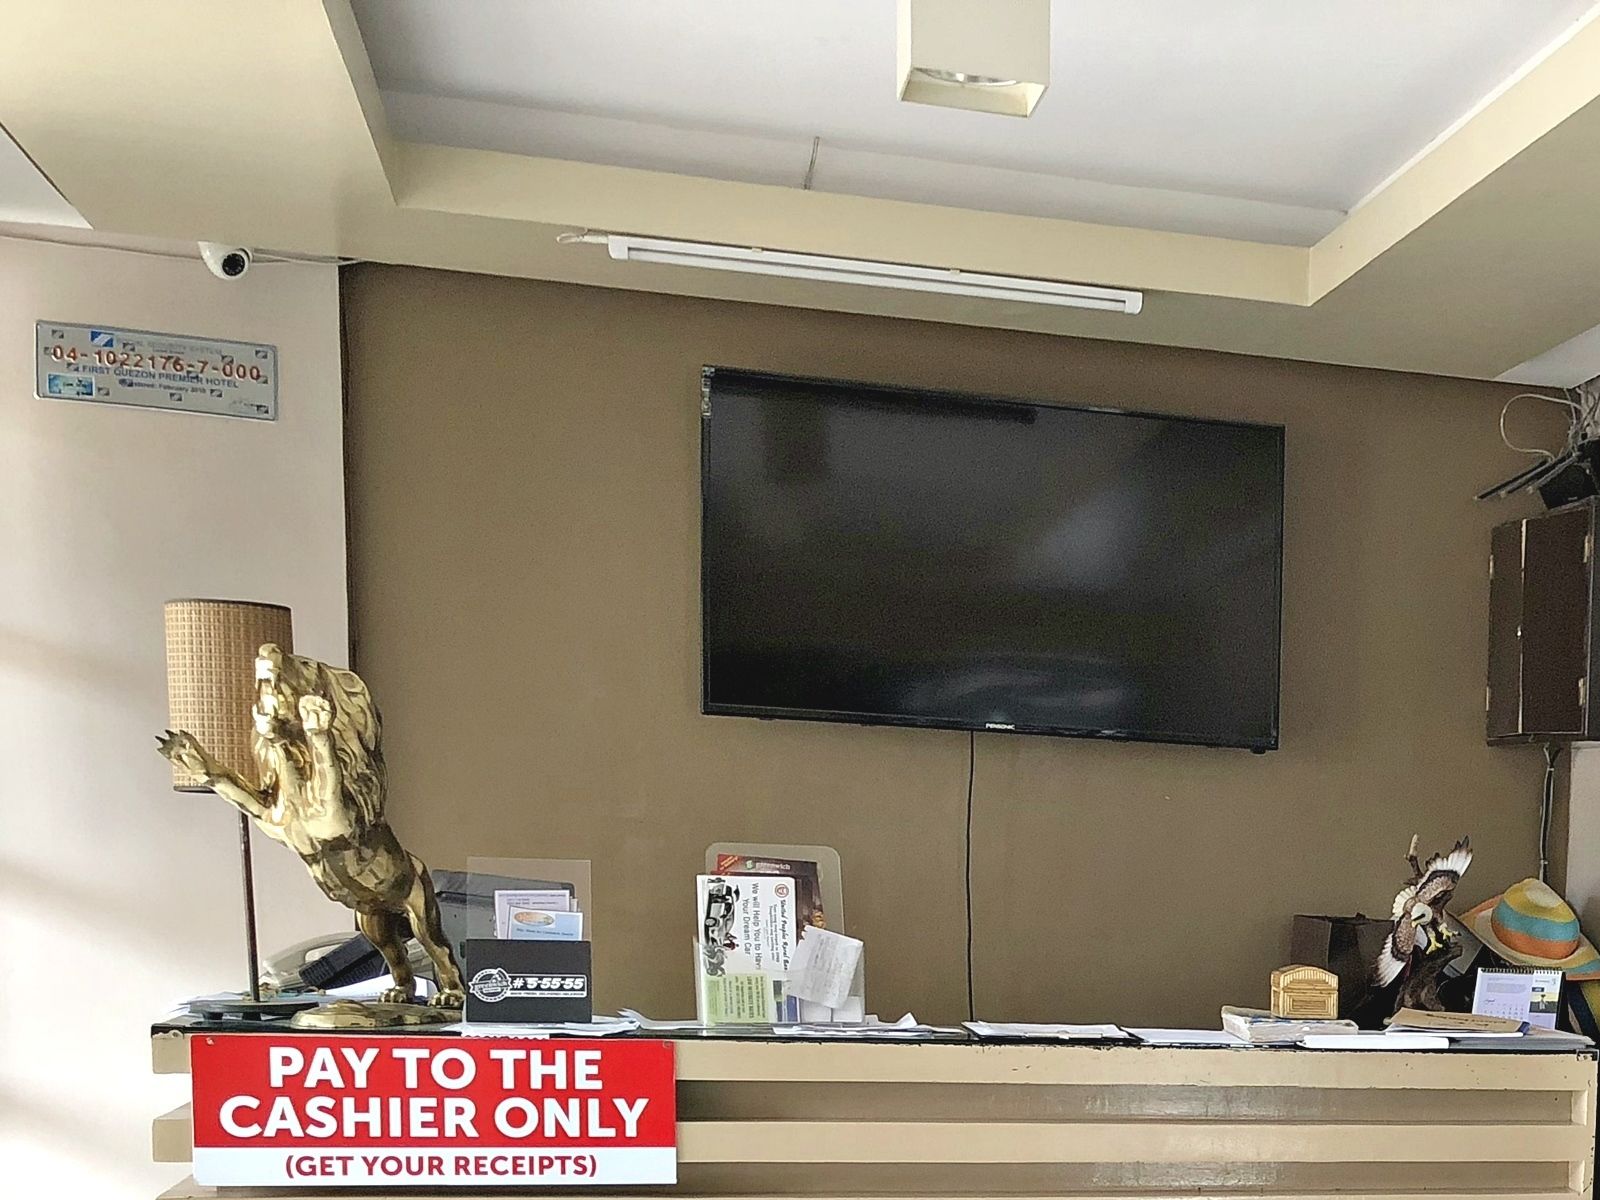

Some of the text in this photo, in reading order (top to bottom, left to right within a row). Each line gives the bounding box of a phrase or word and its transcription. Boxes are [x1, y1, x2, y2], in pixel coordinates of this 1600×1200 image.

[82, 365, 239, 389] FIRST QUEZON PREMIER HOTEL
[752, 883, 760, 894] We
[752, 910, 760, 926] Help
[743, 917, 751, 941] Dream
[744, 942, 752, 955] Car
[754, 943, 761, 951] to
[526, 977, 585, 990] 5-55-55
[268, 1046, 603, 1090] PAY TO THE
[219, 1095, 649, 1139] CASHIER ONLY
[286, 1154, 597, 1179] (GET YOUR RECEIPTS)
